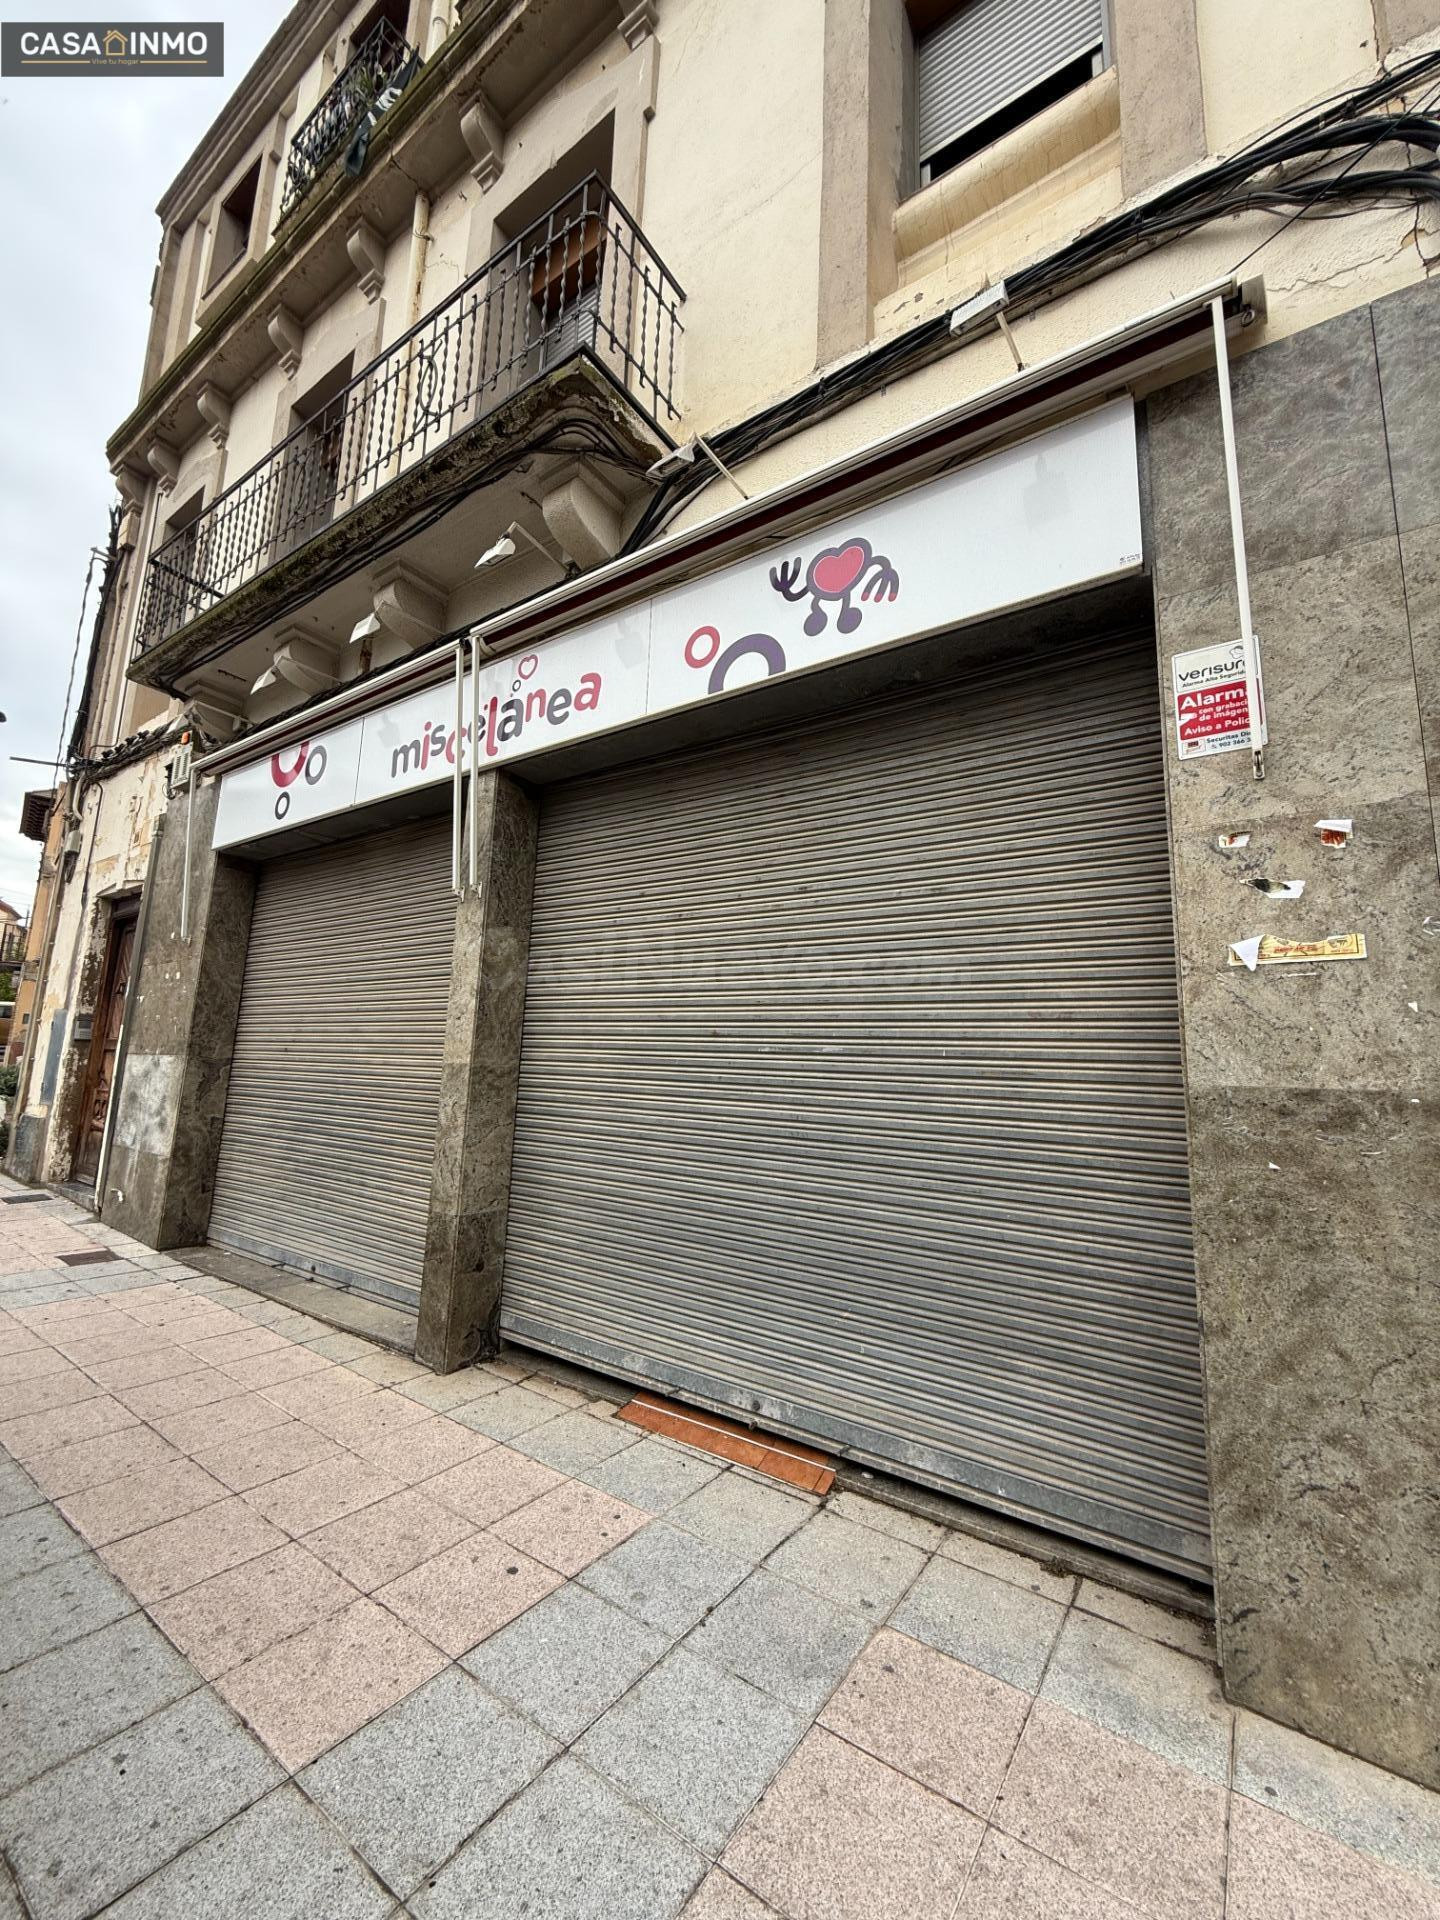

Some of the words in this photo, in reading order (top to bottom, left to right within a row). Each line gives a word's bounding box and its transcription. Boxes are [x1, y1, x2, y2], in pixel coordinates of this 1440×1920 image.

[1178, 659, 1245, 682] verisur
[1180, 687, 1248, 711] Alarm
[1199, 706, 1213, 715] con
[1215, 699, 1248, 712] grabaci
[1199, 713, 1212, 721] de
[1213, 707, 1249, 719] imágen
[1184, 725, 1213, 736] Aviso
[1224, 716, 1251, 728] Polic
[1206, 733, 1239, 743] Securitas
